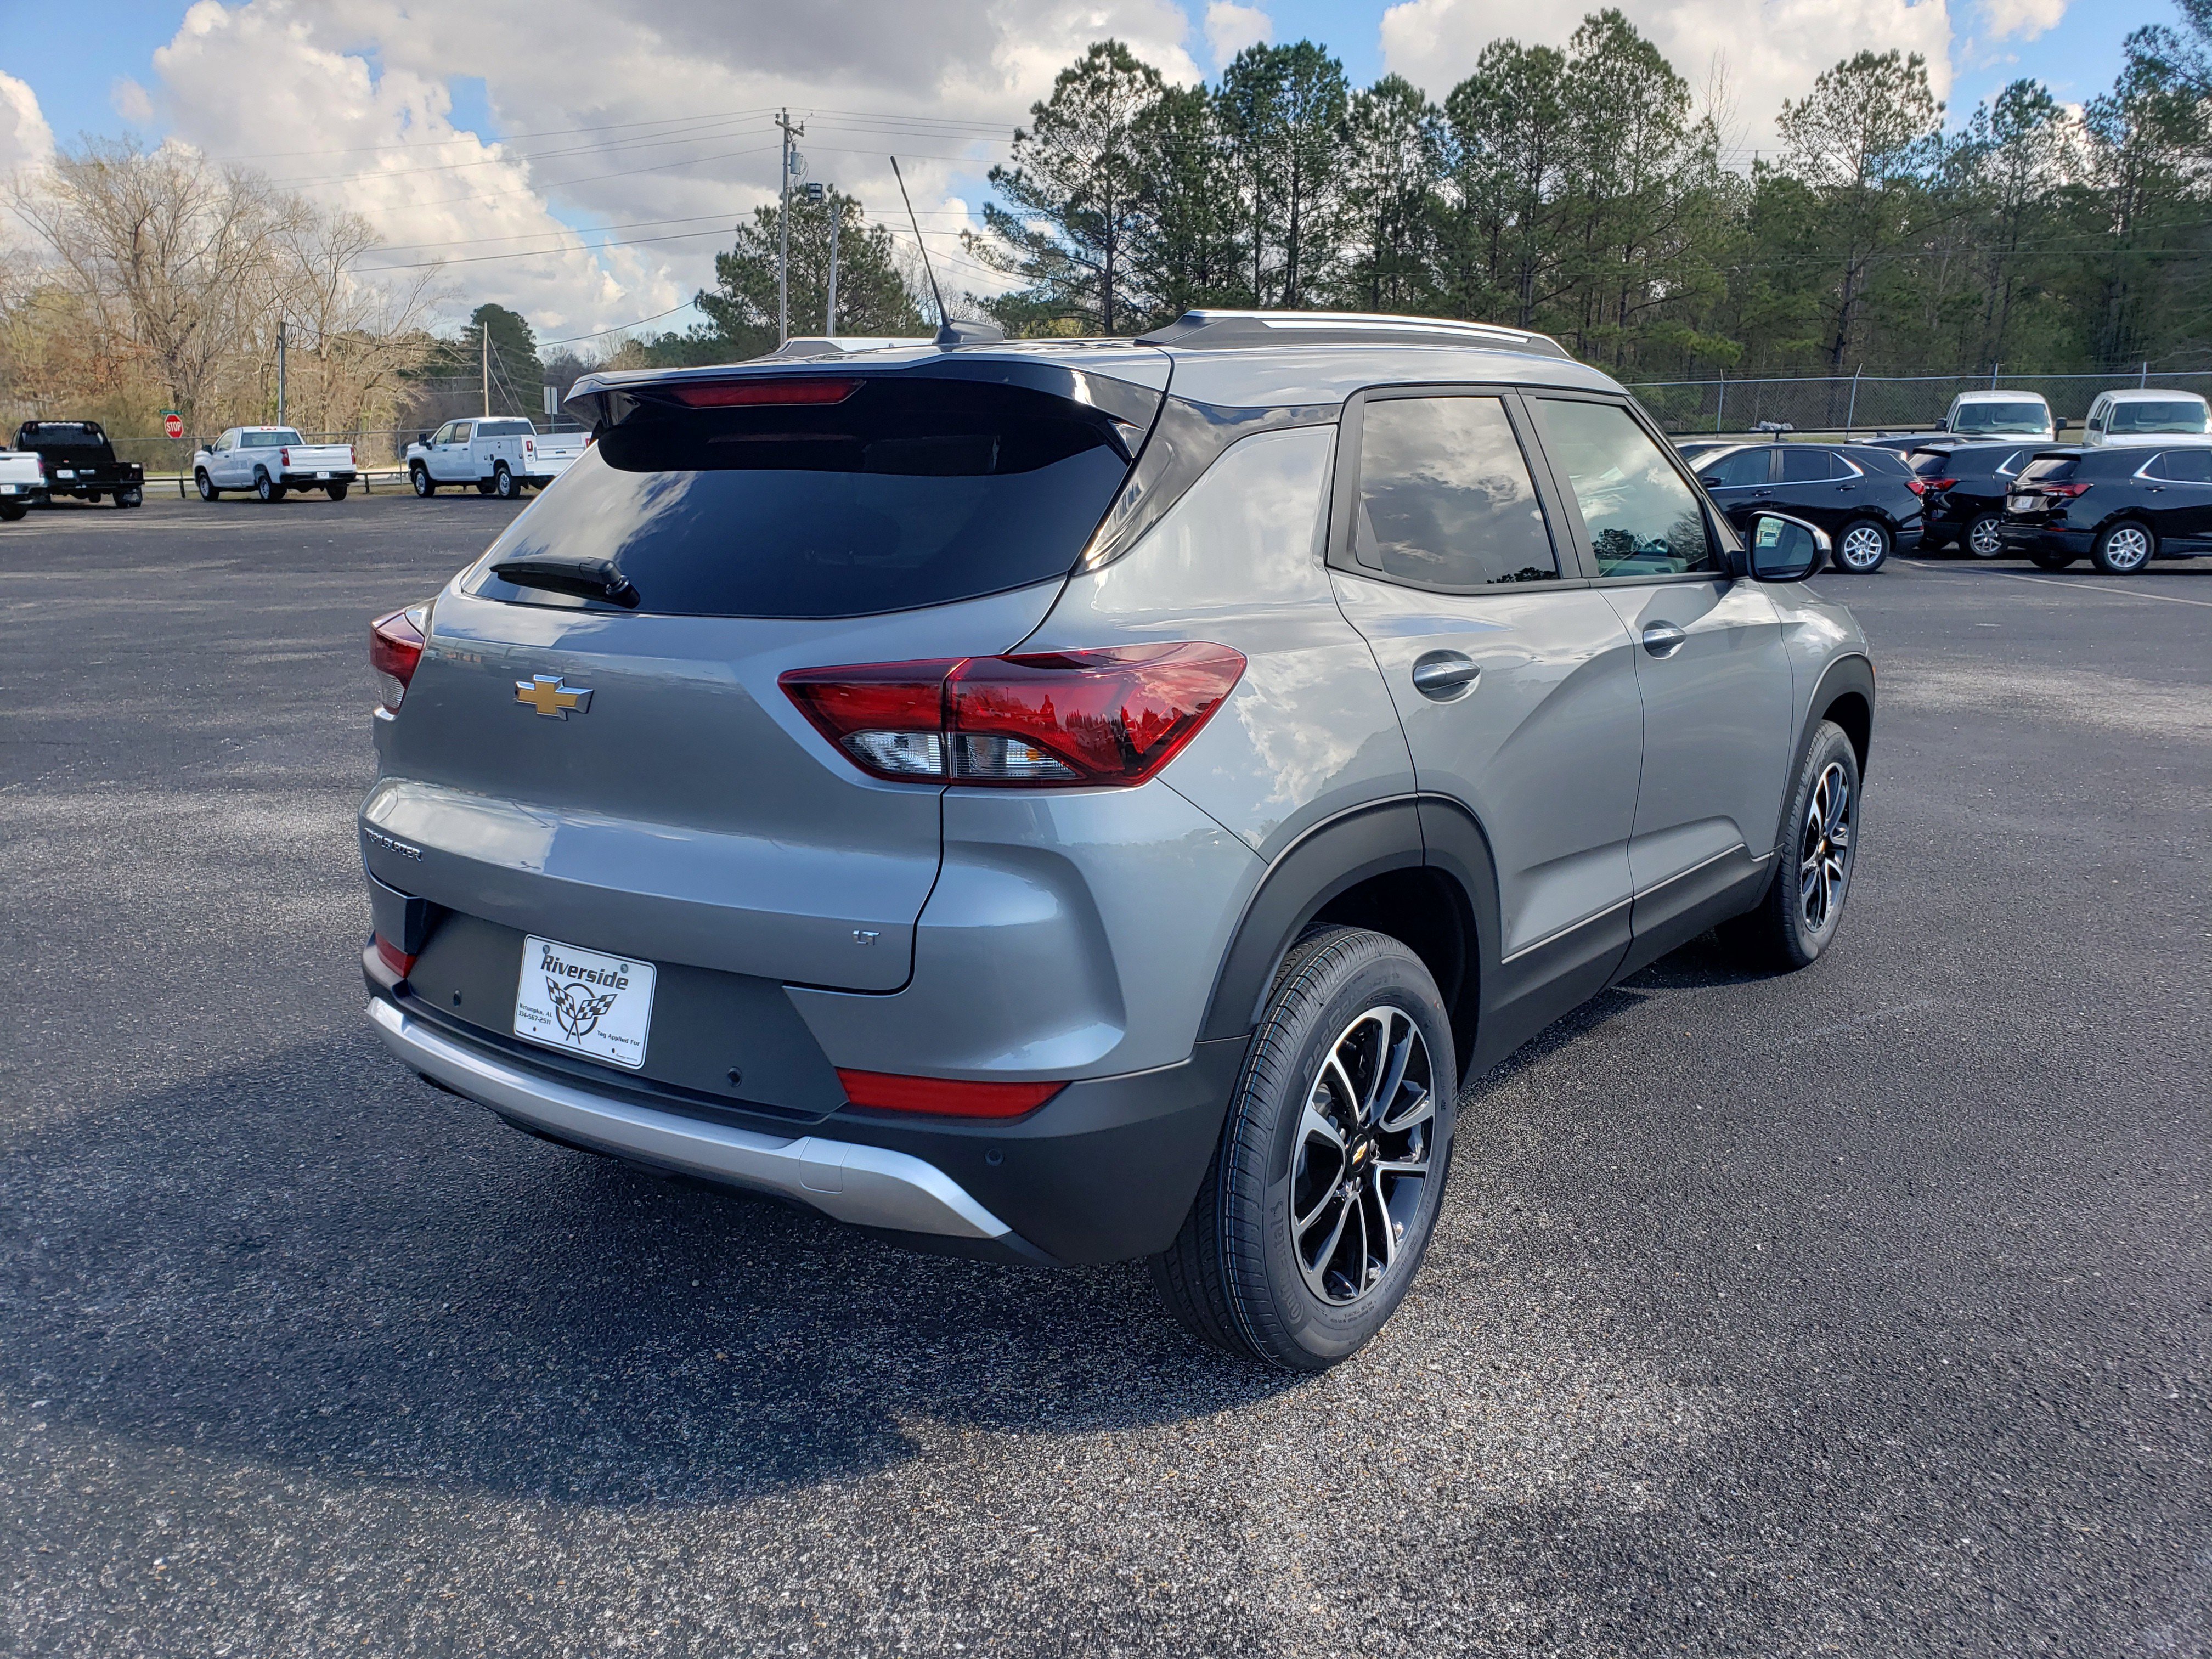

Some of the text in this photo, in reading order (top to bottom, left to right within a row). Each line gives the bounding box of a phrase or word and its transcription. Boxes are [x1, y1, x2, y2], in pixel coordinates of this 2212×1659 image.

[166, 421, 181, 432] STOP
[852, 930, 880, 946] LT
[540, 954, 629, 990] Riverside
[518, 1010, 551, 1025] 334-567-2511
[597, 1030, 607, 1039] Tag
[607, 1034, 629, 1043] Applied
